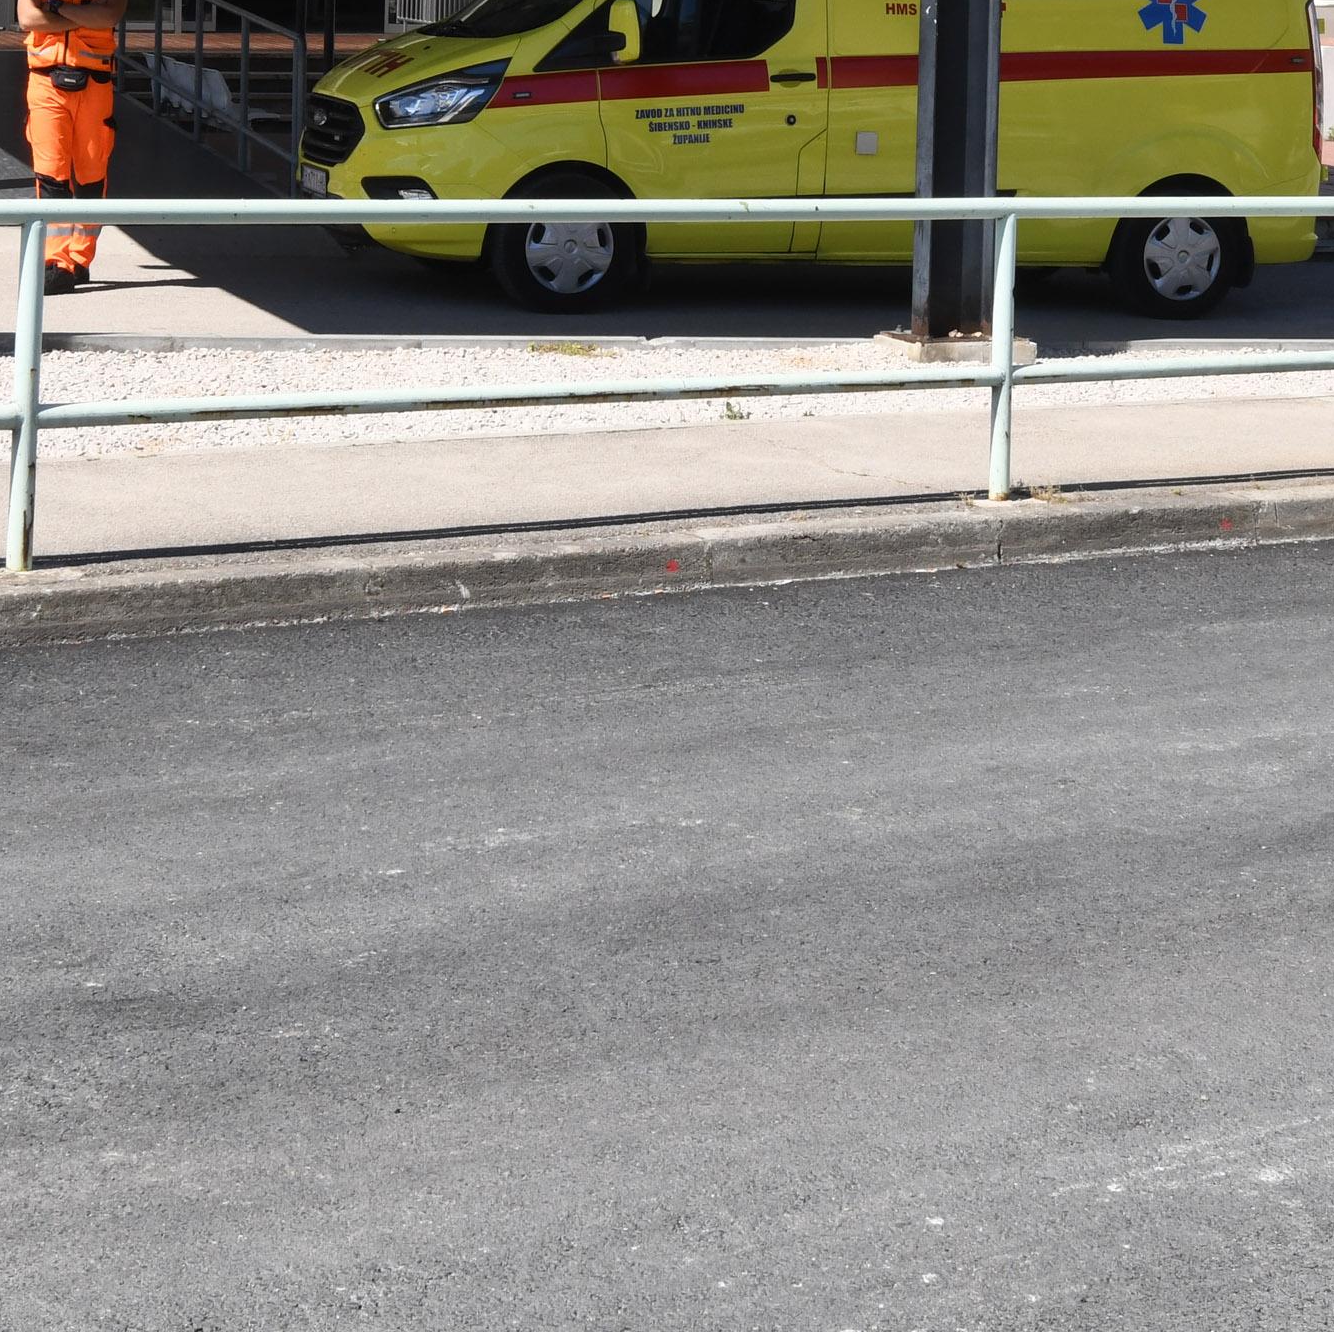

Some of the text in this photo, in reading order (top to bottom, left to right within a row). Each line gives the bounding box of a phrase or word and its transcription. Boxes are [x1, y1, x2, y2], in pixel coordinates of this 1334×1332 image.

[885, 3, 918, 16] HMS
[635, 104, 745, 120] ZAVOD ZA HITNU MEDICINU
[648, 121, 691, 133] ŠIBENSKO
[697, 118, 733, 129] KNINSKE
[673, 133, 710, 145] ŽUPANIJE
